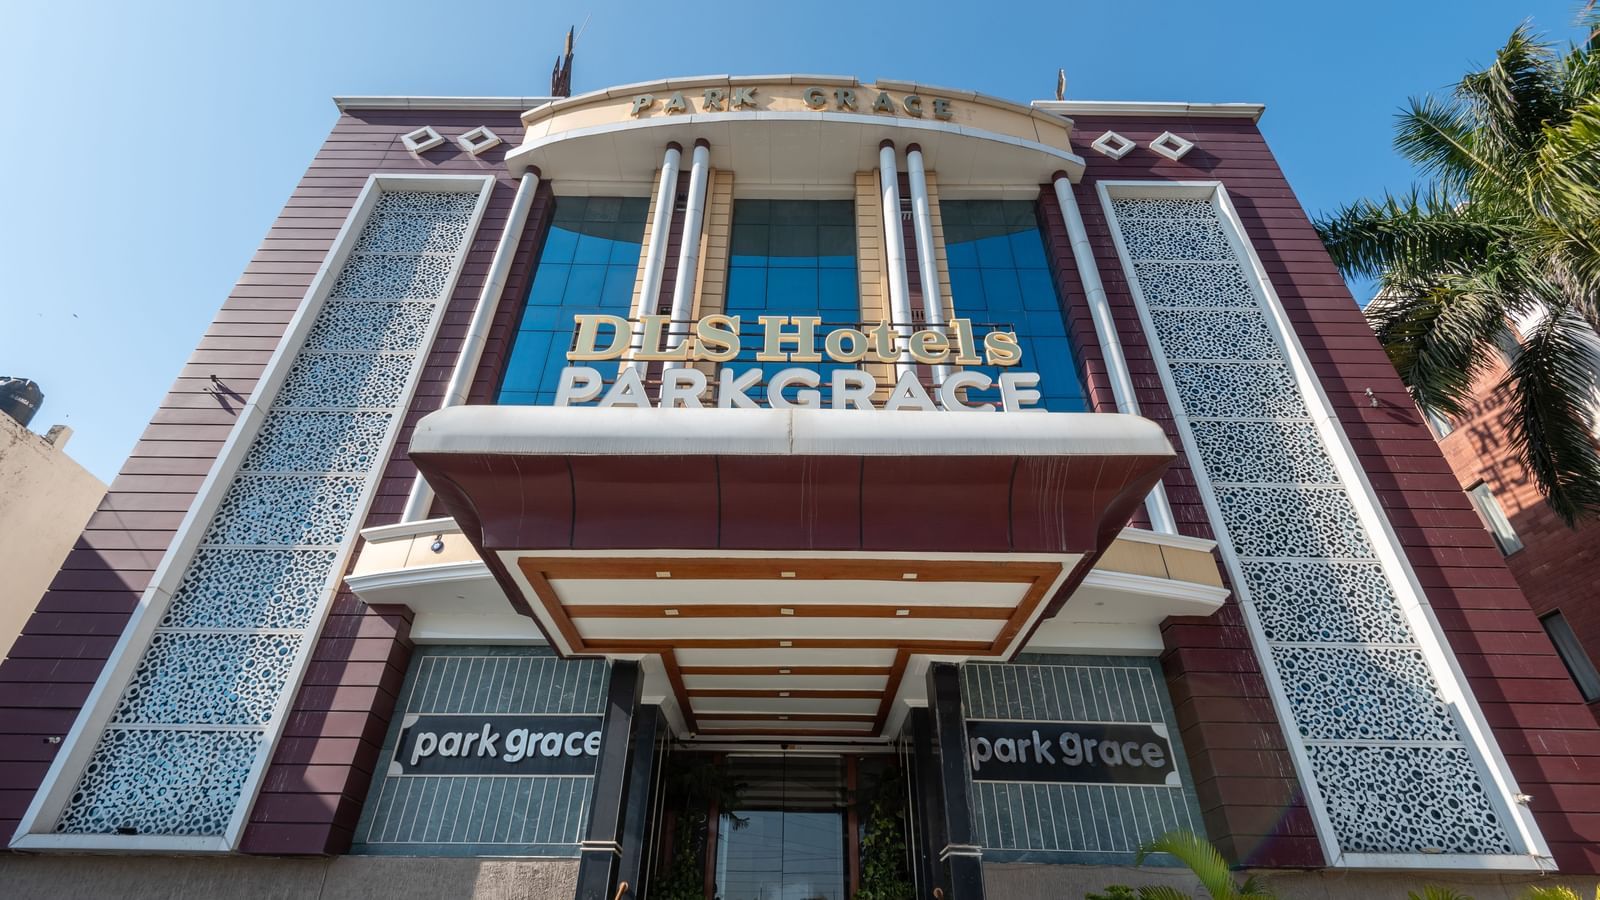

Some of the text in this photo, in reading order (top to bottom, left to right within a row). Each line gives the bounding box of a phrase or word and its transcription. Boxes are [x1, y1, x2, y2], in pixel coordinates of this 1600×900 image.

[631, 87, 953, 120] PARK GRACE
[566, 314, 1022, 365] DLS Hotels
[410, 723, 602, 766] park grace
[970, 730, 1165, 771] park grace
